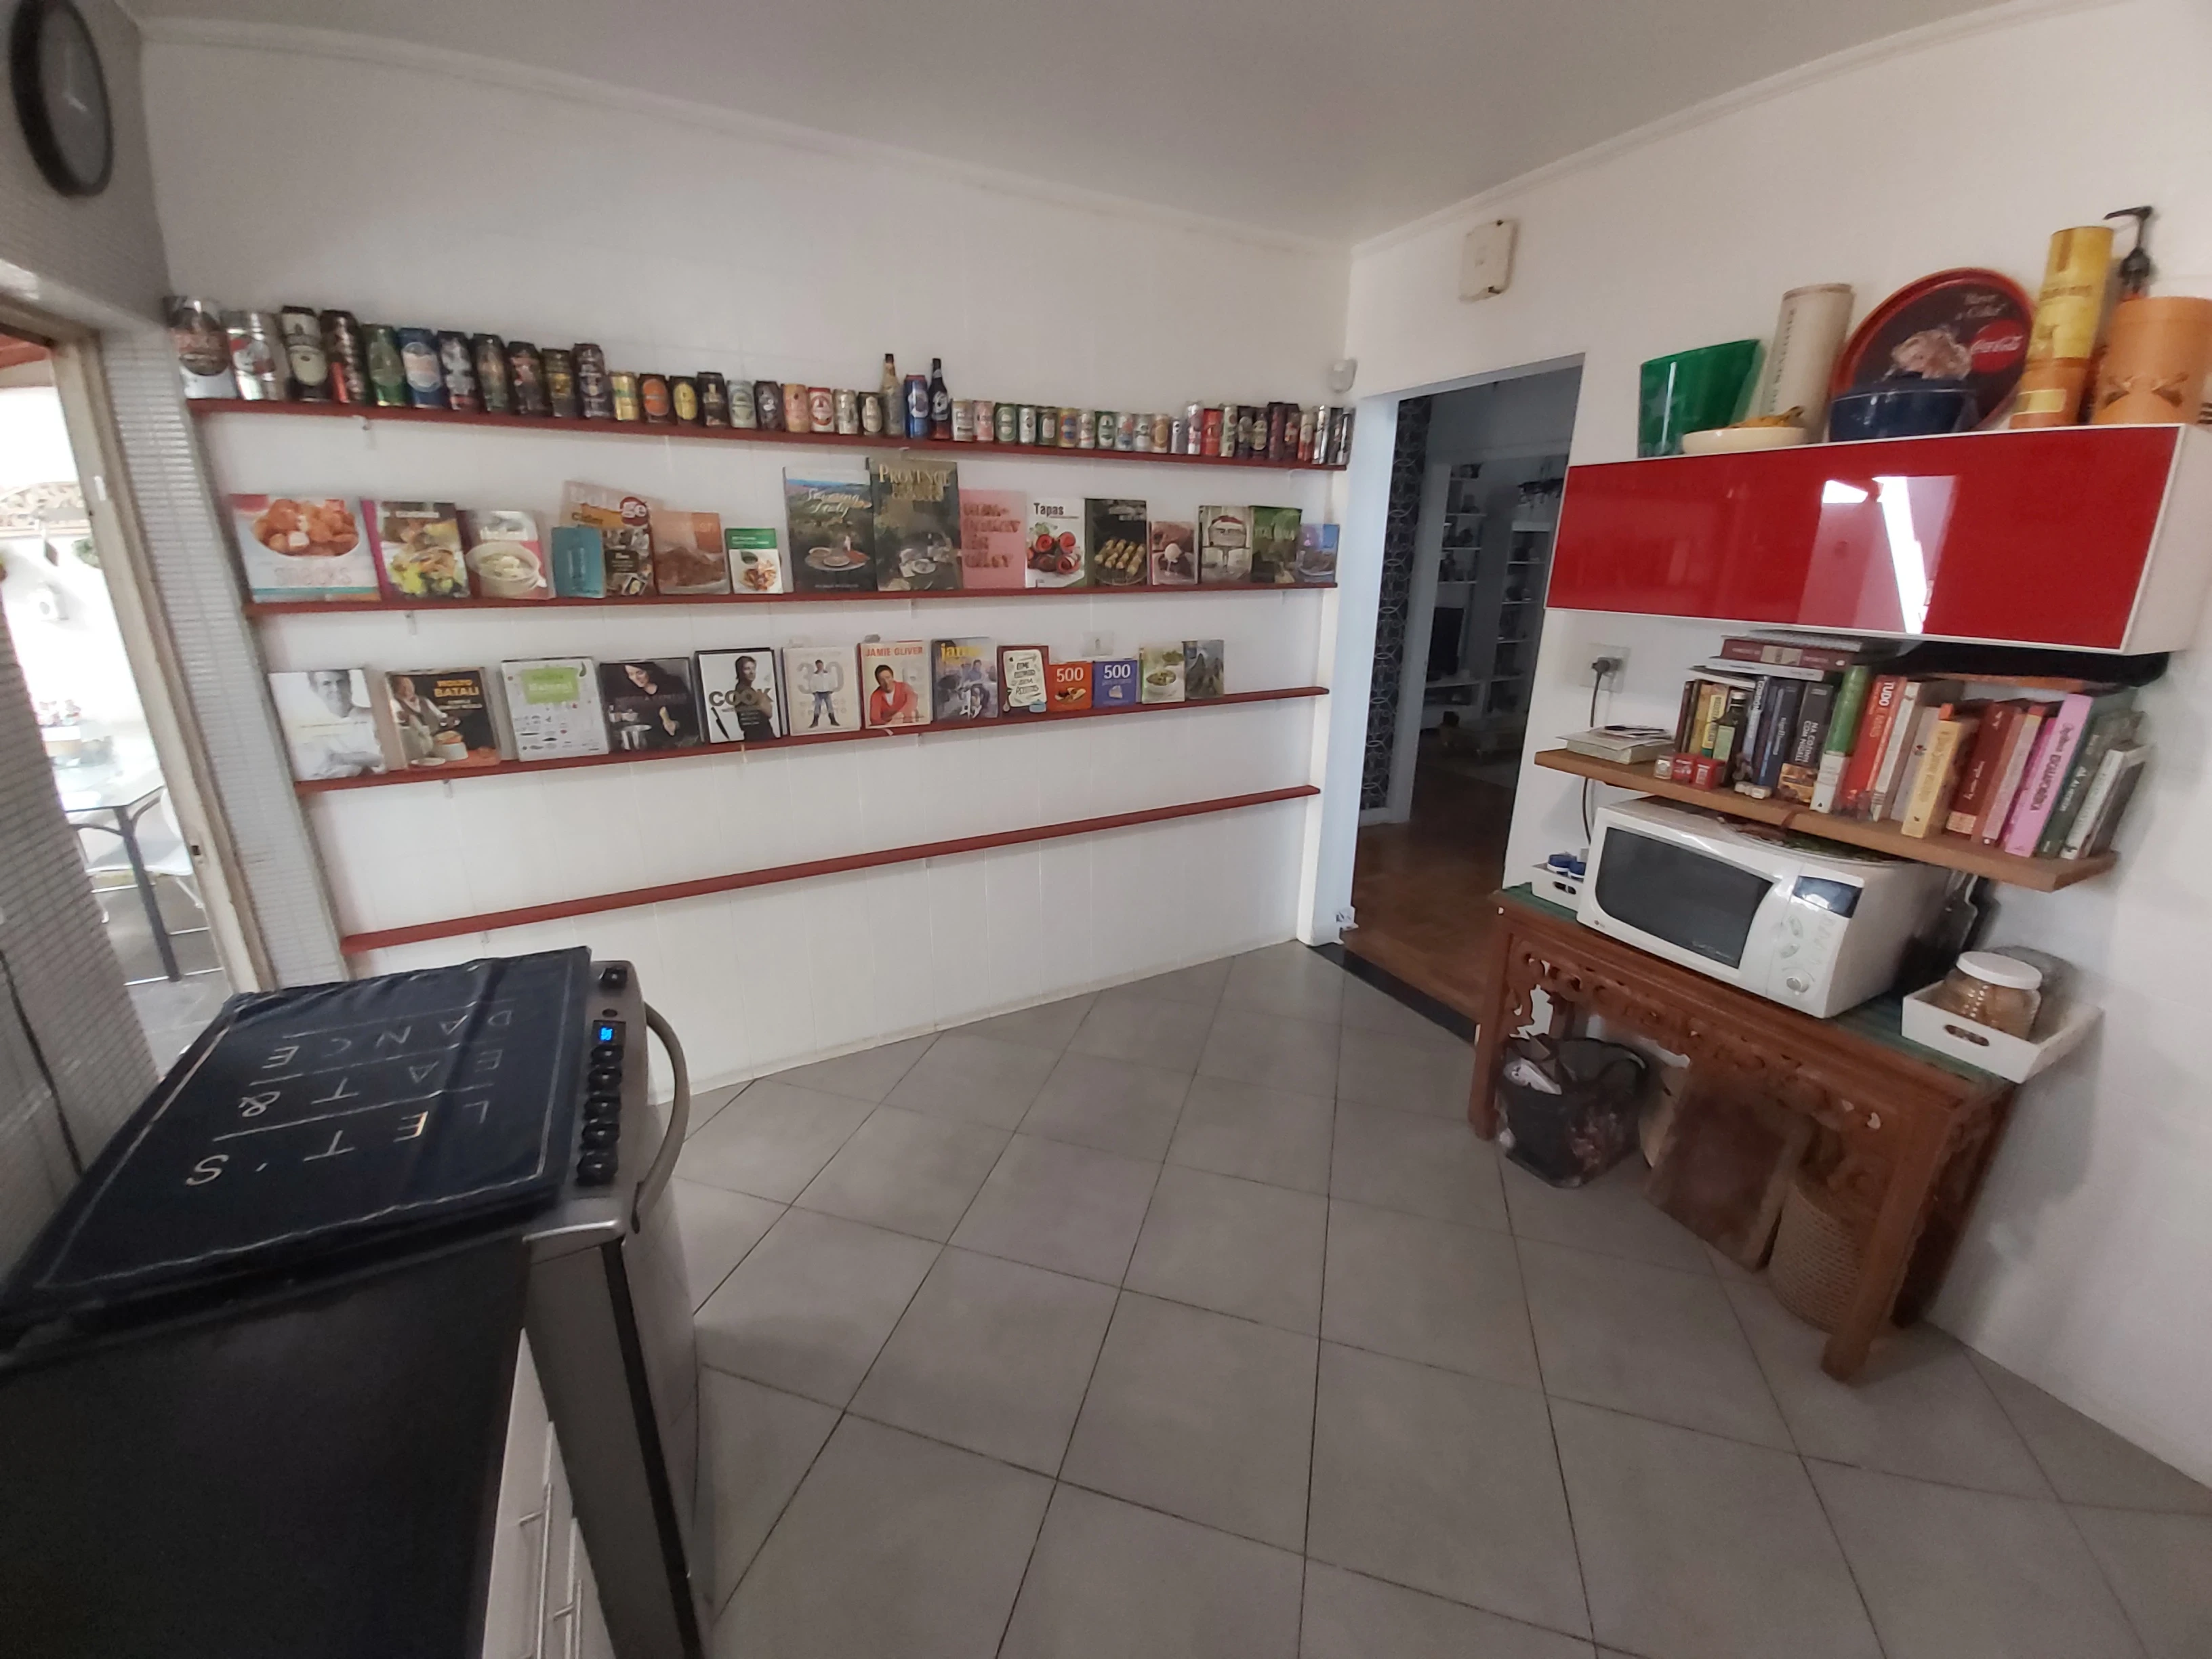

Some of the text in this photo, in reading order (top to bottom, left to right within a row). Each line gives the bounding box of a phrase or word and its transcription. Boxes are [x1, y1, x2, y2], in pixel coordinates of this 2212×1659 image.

[1033, 502, 1064, 518] Tapas
[865, 646, 924, 657] JAMIE OLIVER
[1056, 666, 1084, 683] 500
[1103, 663, 1132, 680] 500
[434, 686, 480, 698] BATALI
[1879, 681, 1895, 706] TUDO
[261, 1008, 514, 1069] DANCE
[236, 1048, 504, 1119] EAT &
[183, 1099, 491, 1187] LET'S
